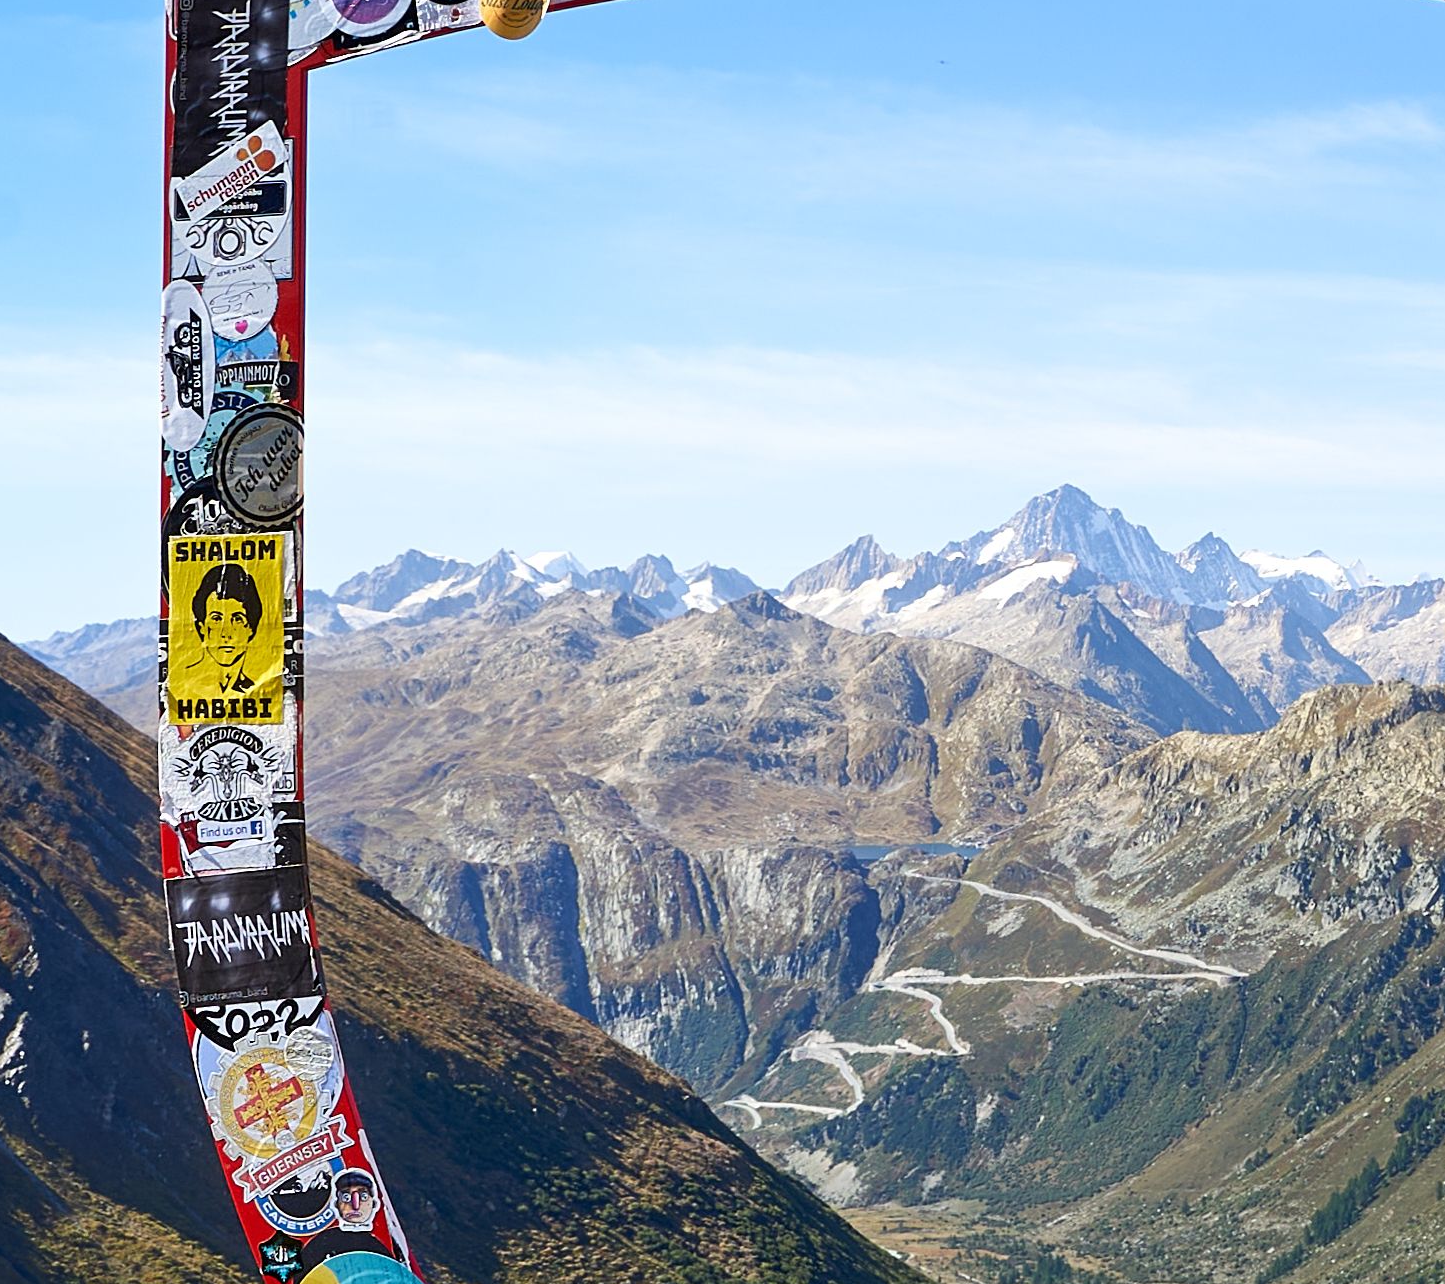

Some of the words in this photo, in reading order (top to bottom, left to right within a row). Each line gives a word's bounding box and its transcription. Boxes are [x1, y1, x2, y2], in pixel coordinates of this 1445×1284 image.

[185, 158, 256, 213] schumann
[218, 170, 261, 202] reisen
[191, 320, 202, 361] RUOTE
[191, 364, 202, 388] DUE
[234, 465, 263, 503] Ich
[262, 425, 294, 466] war
[267, 440, 303, 493] dabei
[174, 539, 277, 563] SHALOM
[177, 697, 273, 720] HABIBI
[190, 727, 263, 762] CEREDIGION
[198, 799, 262, 821] BIKERS
[199, 822, 222, 839] Find
[222, 826, 234, 837] us
[235, 824, 248, 835] on
[257, 1136, 329, 1187] GUERNSEY
[261, 1200, 335, 1233] CAFETERO
